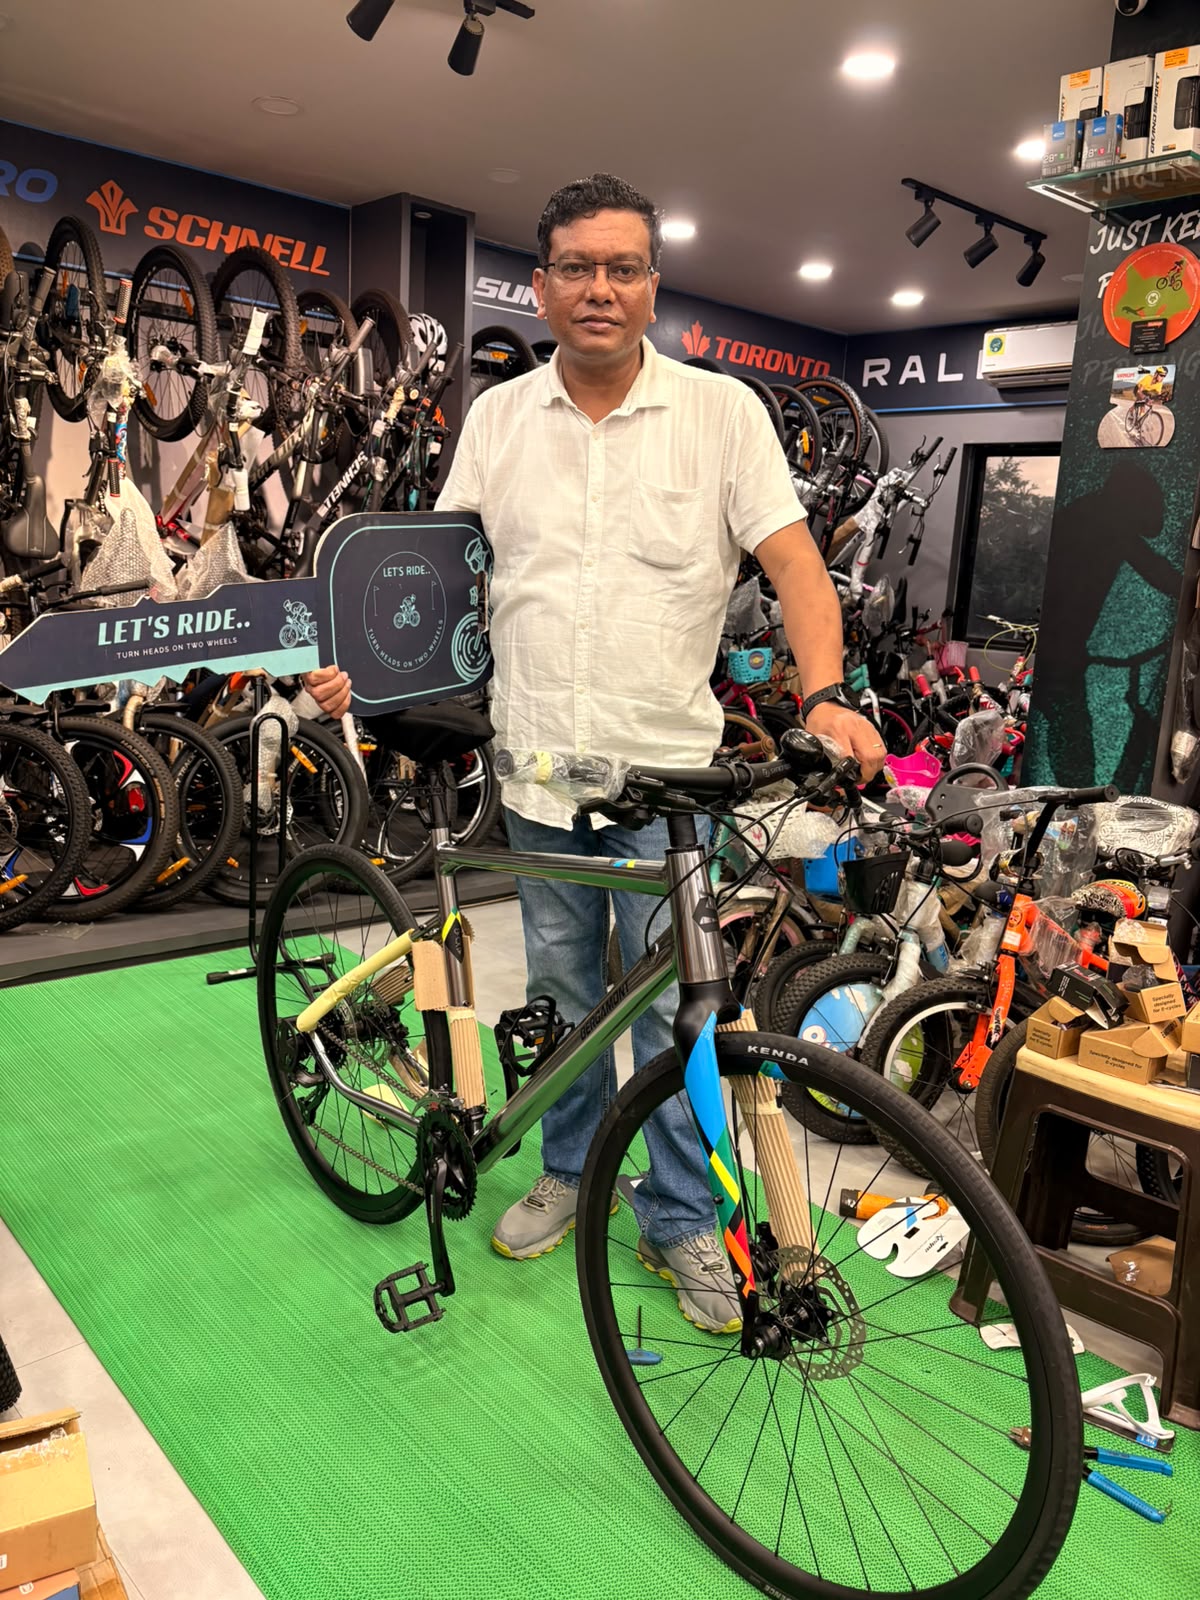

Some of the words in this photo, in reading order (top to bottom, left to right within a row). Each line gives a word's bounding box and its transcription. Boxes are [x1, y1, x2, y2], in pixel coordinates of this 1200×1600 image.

[1089, 213, 1162, 254] JUST
[714, 336, 831, 378] TORONTO
[323, 450, 369, 509] SCHNELL
[383, 566, 404, 577] LET'S
[406, 565, 431, 576] RIDE..
[98, 615, 170, 646] LET'S
[177, 608, 250, 636] RIDE..
[368, 628, 380, 650] TURN
[380, 650, 401, 668] HEADS
[414, 652, 429, 664] TWO
[428, 619, 443, 652] WHEELS
[117, 650, 140, 659] TURN
[143, 646, 170, 656] HEADS
[172, 643, 184, 652] ON
[186, 641, 204, 650] TWO
[206, 637, 238, 647] WHEELS
[580, 979, 630, 1041] BERGAMONT
[747, 1045, 809, 1066] KENDA
